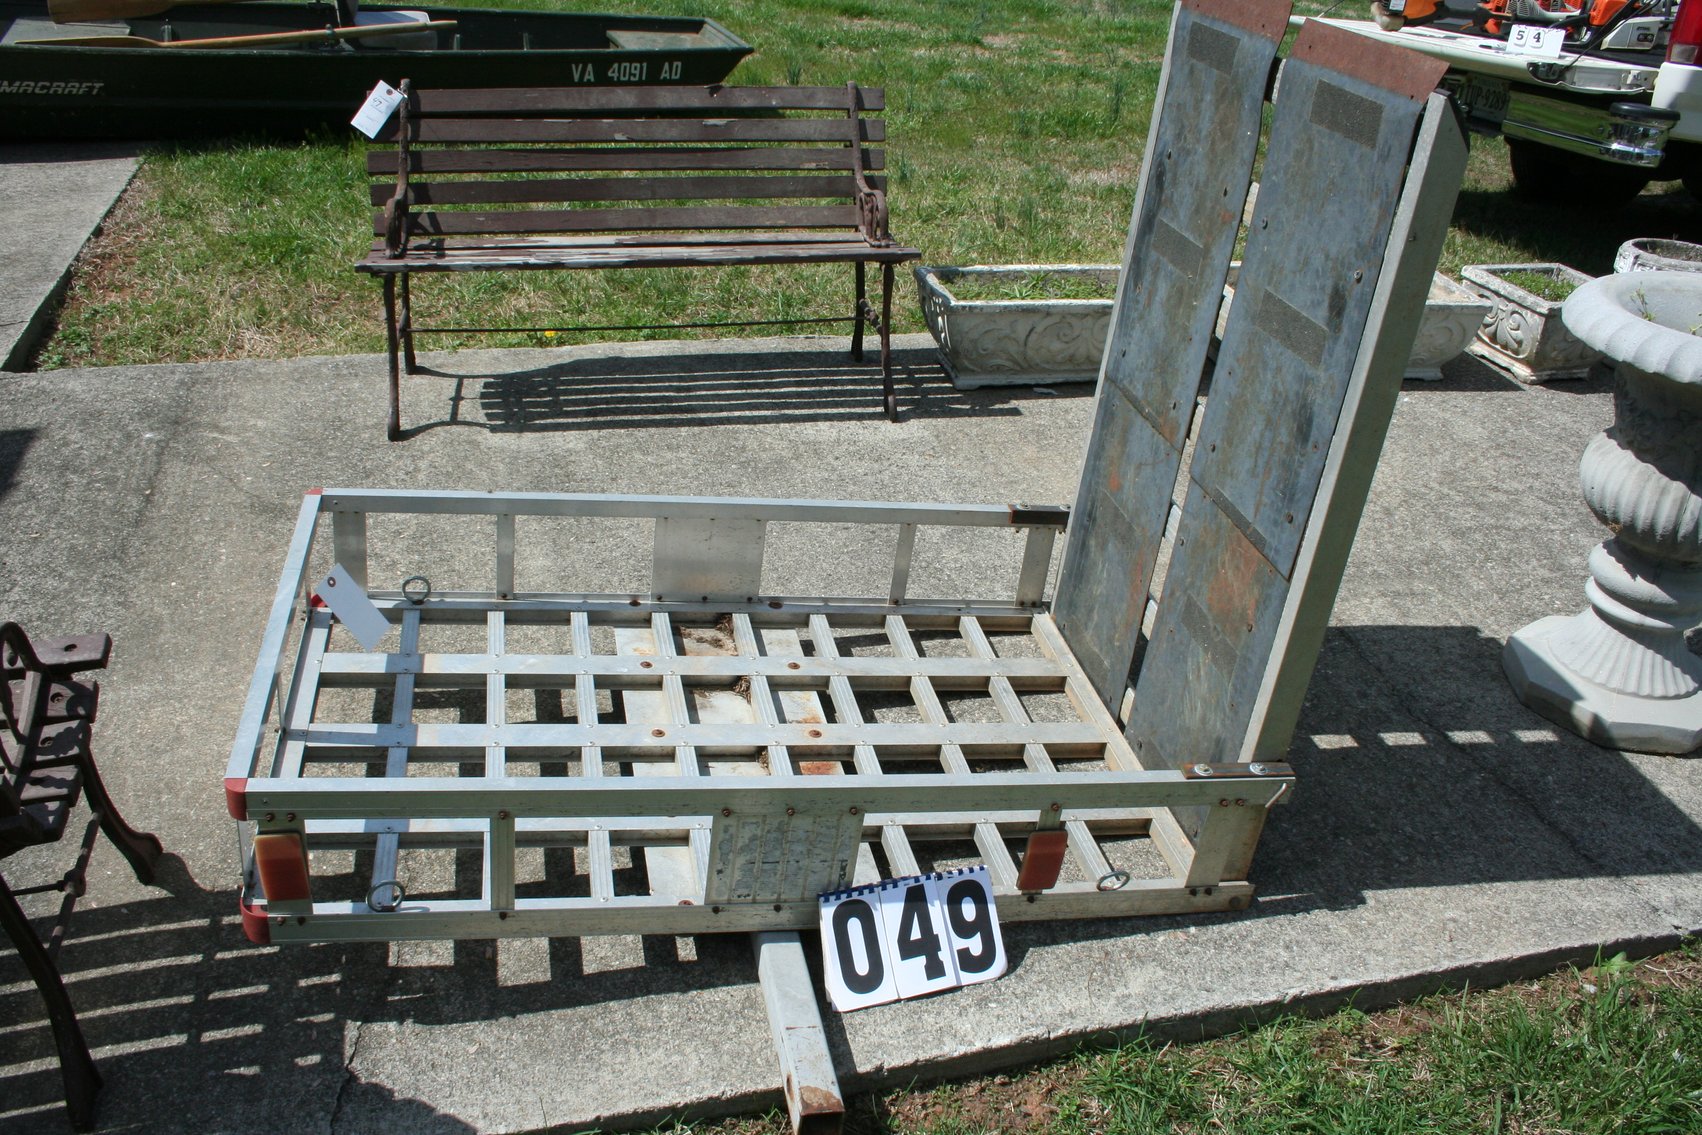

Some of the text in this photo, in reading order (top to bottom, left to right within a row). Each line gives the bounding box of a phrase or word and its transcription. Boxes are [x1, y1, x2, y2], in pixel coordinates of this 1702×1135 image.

[571, 63, 595, 82] VA
[607, 62, 647, 81] 4091
[0, 80, 105, 95] MACRAFT
[832, 879, 997, 995] 049
